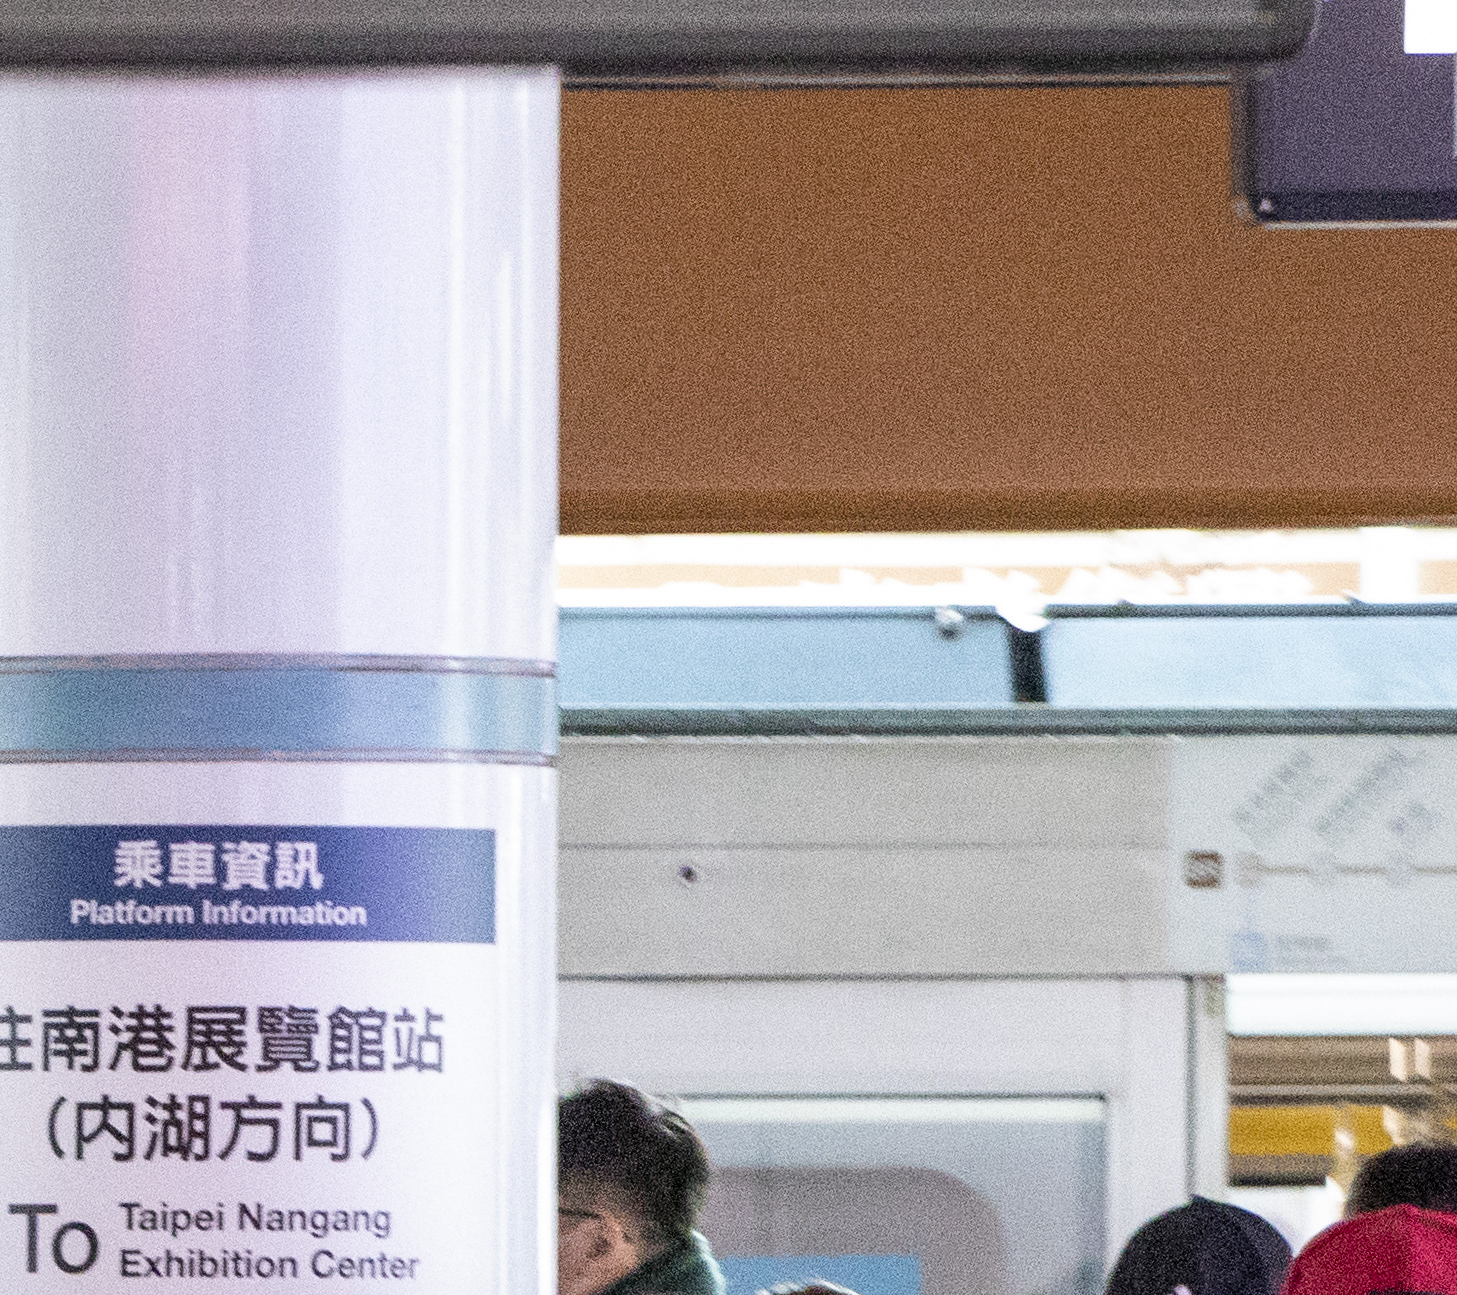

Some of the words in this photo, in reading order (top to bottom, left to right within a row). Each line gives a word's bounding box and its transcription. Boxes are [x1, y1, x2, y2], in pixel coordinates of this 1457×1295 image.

[114, 839, 325, 891] 乘車資訊
[70, 899, 194, 925] Platform
[203, 900, 368, 926] Information
[8, 1203, 101, 1275] To
[118, 1202, 225, 1239] Taipei
[237, 1202, 391, 1240] Nangang
[119, 1248, 299, 1279] Exhibition
[309, 1248, 419, 1281] Center
